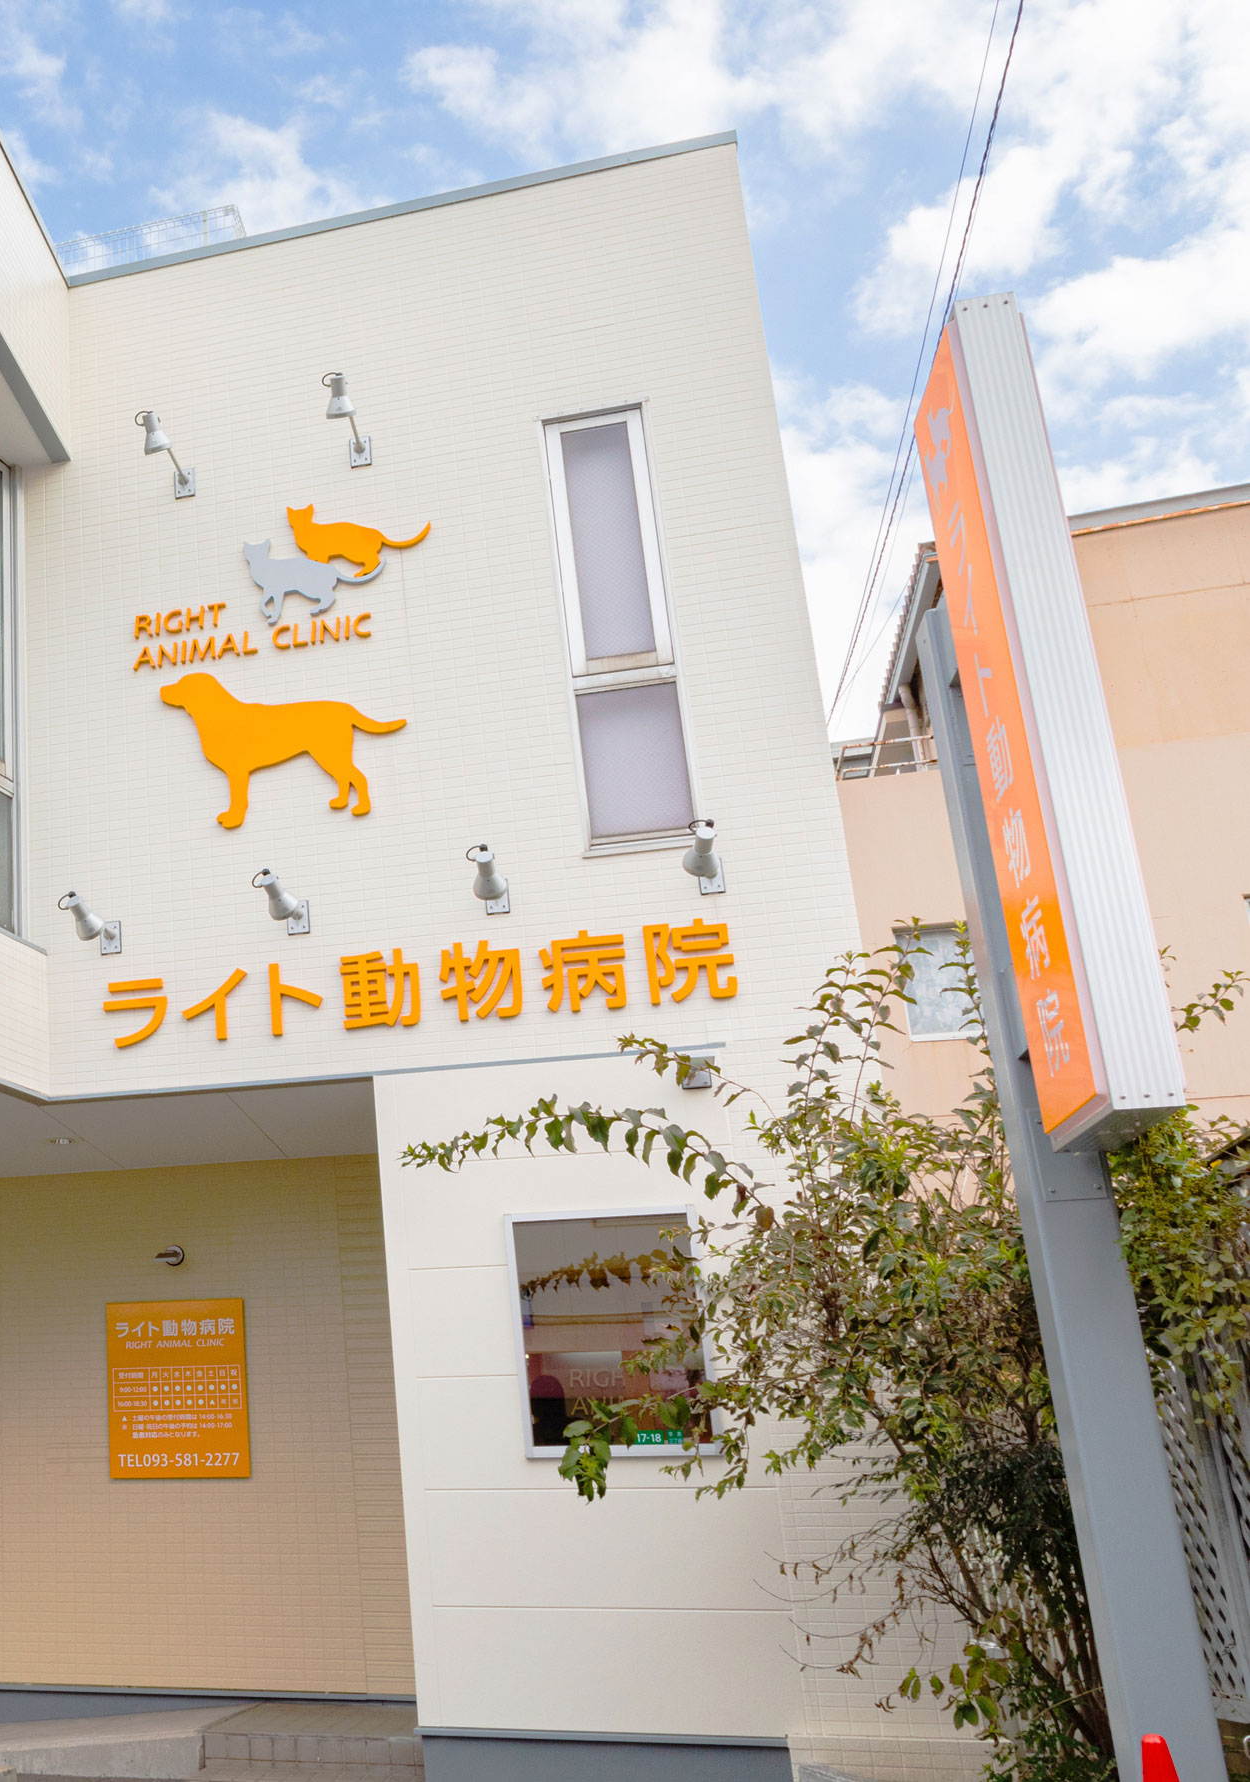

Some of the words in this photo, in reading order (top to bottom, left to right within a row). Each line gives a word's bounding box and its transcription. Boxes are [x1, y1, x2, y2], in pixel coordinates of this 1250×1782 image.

[133, 602, 226, 640] RIGHT
[133, 630, 259, 672] ANIMAL
[272, 612, 372, 650] CLINIC
[948, 500, 1071, 1077] ライト動物病院
[103, 918, 738, 1048] ライト動物病院
[115, 1318, 235, 1338] ライト動物病院
[125, 1340, 153, 1350] RIGHT
[156, 1339, 193, 1349] ANIMAL
[196, 1337, 225, 1347] CLINIC
[219, 1369, 226, 1377] 日
[636, 1433, 662, 1443] 17-18
